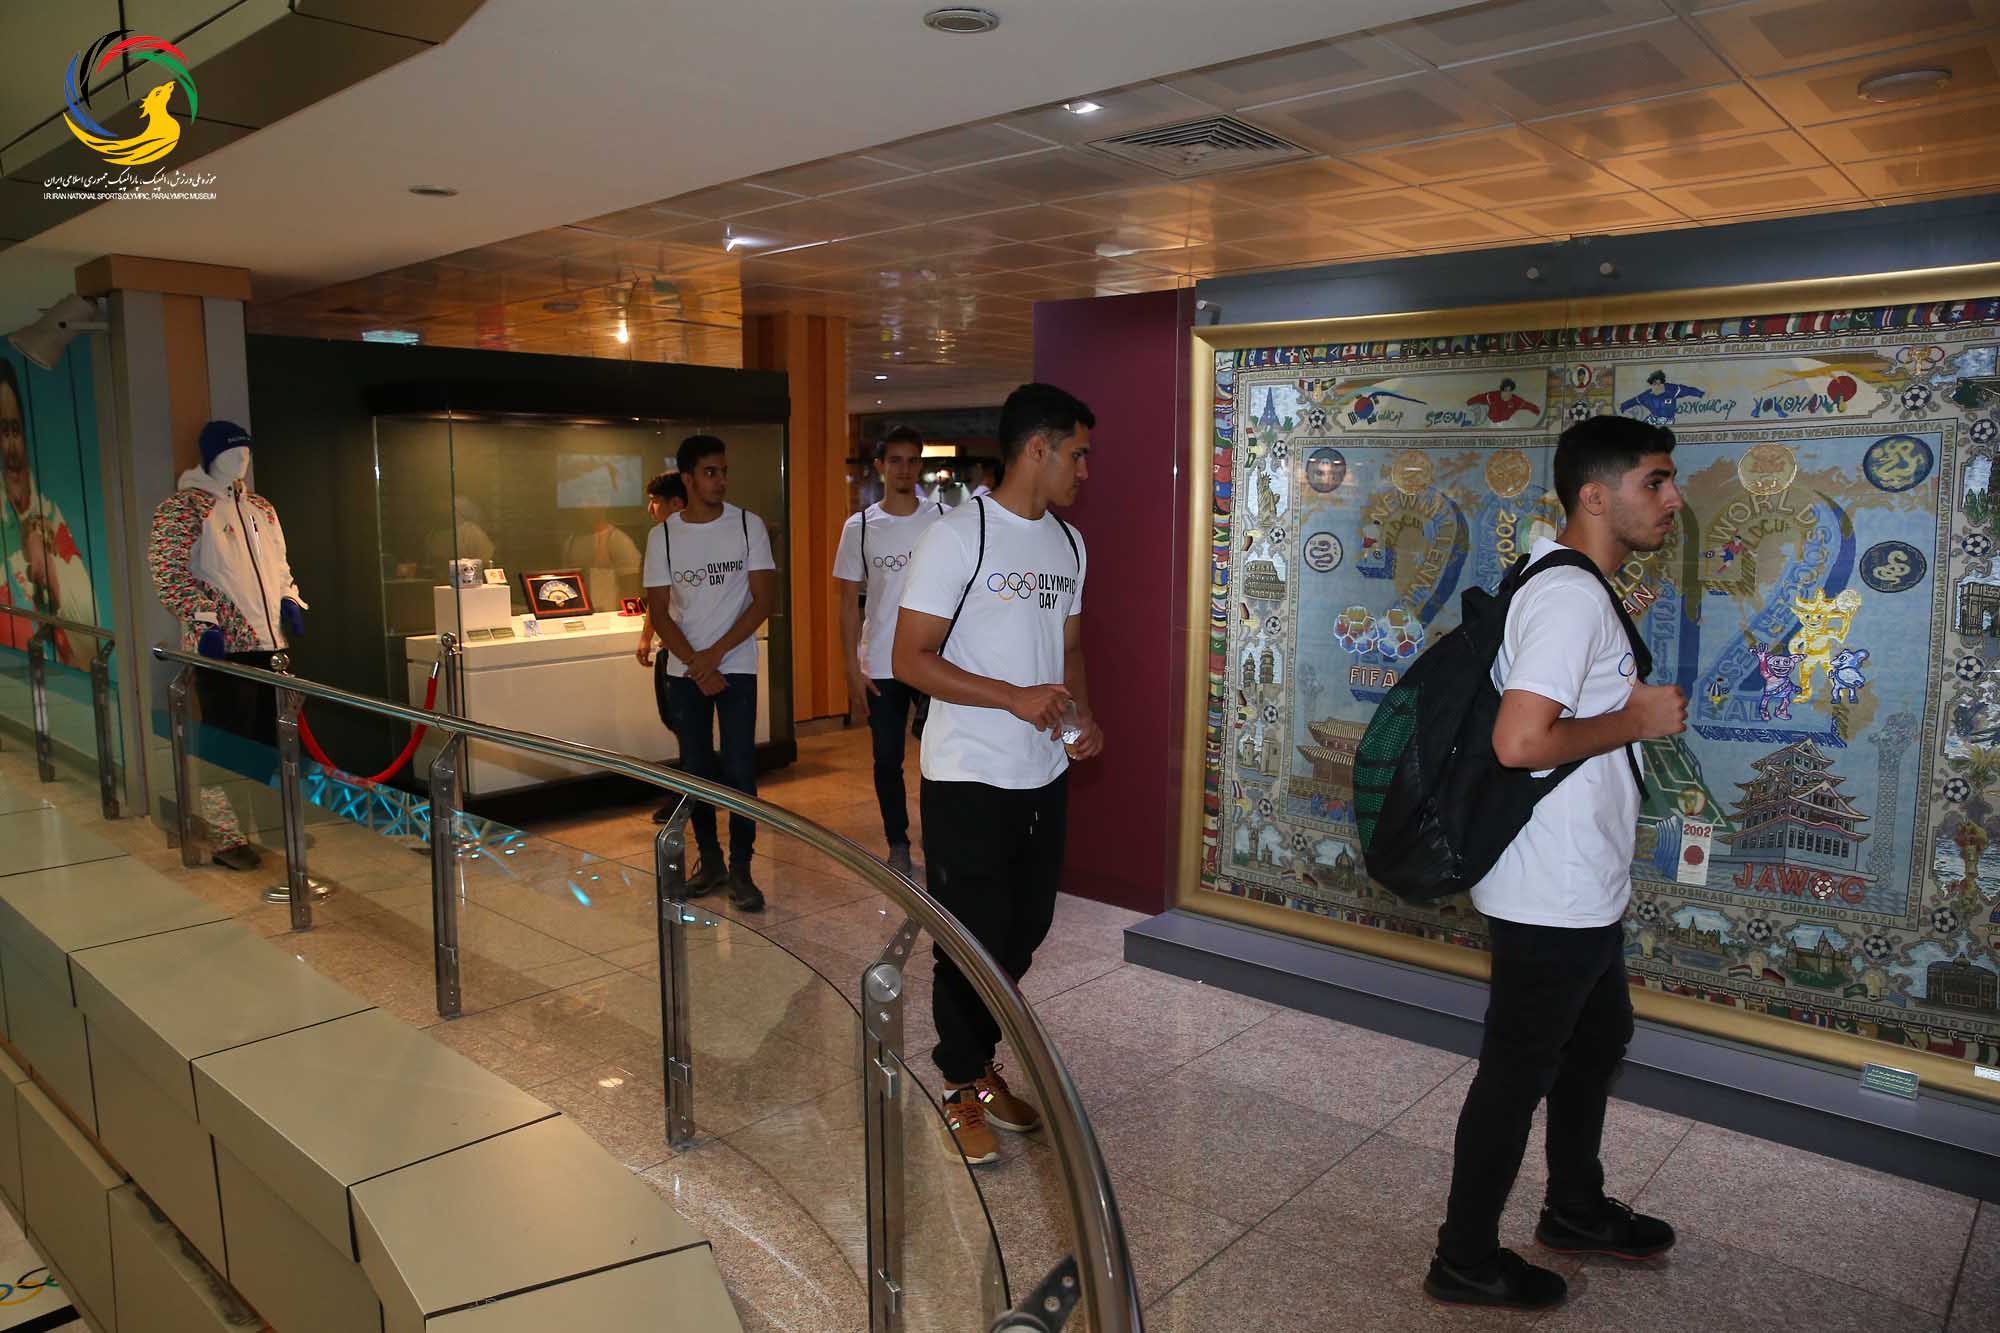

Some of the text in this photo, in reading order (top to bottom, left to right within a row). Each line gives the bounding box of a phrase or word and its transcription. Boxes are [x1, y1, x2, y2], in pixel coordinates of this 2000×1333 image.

[1731, 429, 1769, 441] WORLD
[707, 560, 743, 575] OLYMPIC
[709, 574, 725, 586] DAY
[1038, 573, 1076, 595] OLYMPIC
[1039, 593, 1059, 610] DAY
[1350, 666, 1398, 688] FIFA
[1683, 822, 1712, 838] 2002
